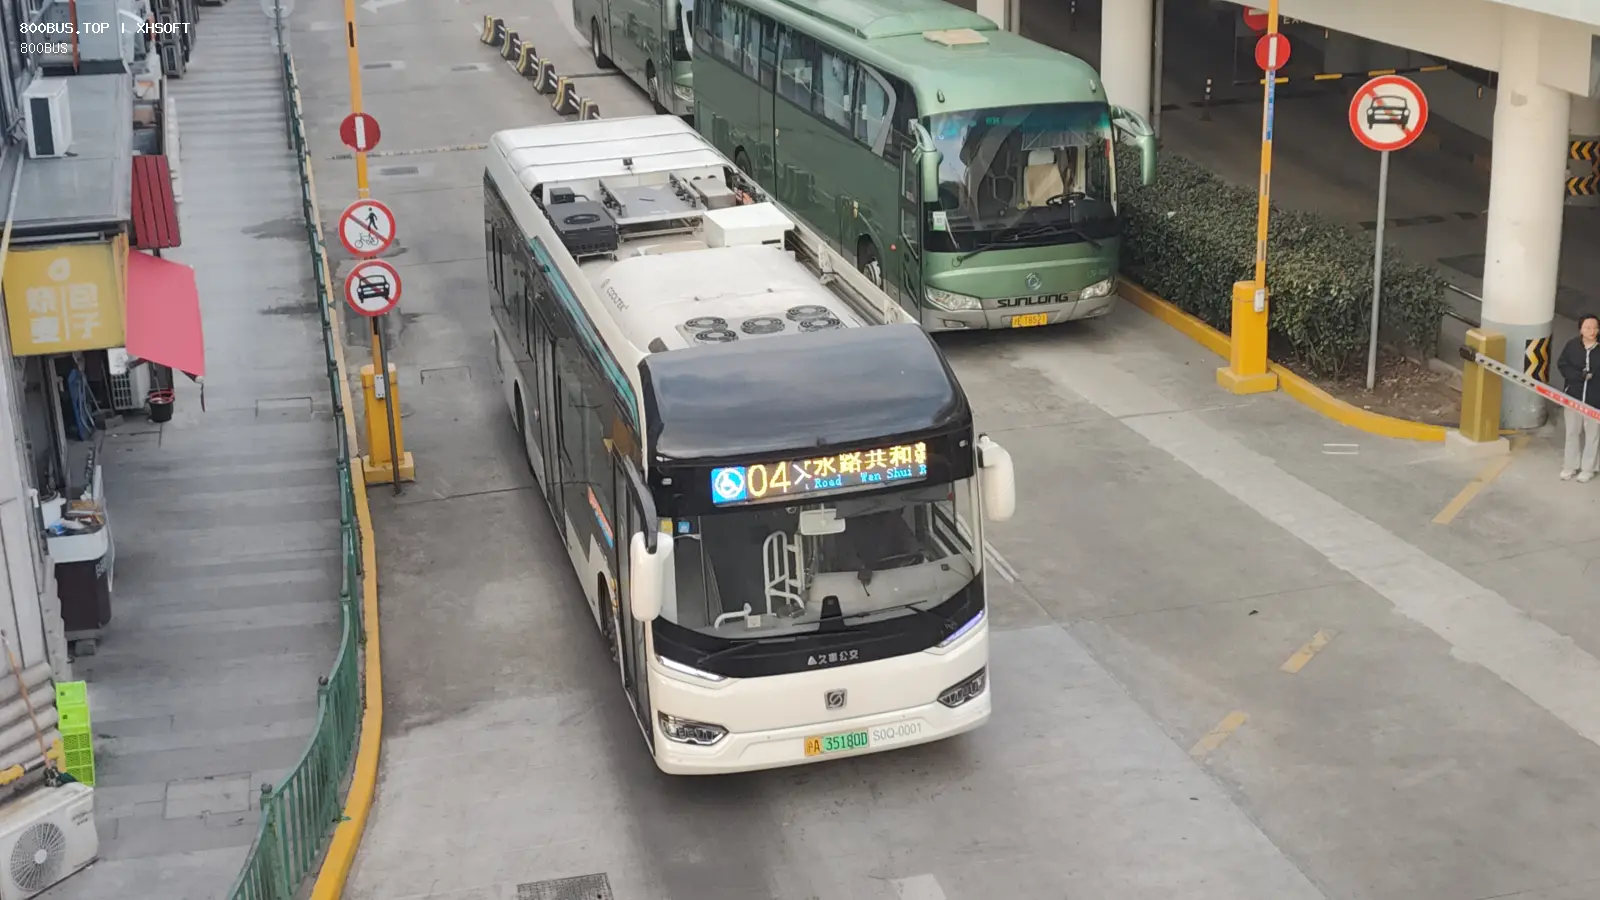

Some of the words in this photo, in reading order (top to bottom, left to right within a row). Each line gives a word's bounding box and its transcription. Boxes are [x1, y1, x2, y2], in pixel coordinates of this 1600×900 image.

[997, 293, 1069, 308] SUNLONG
[814, 473, 843, 489] Road
[860, 471, 882, 483] Wen
[886, 464, 913, 480] Shui
[825, 732, 868, 751] 35180D
